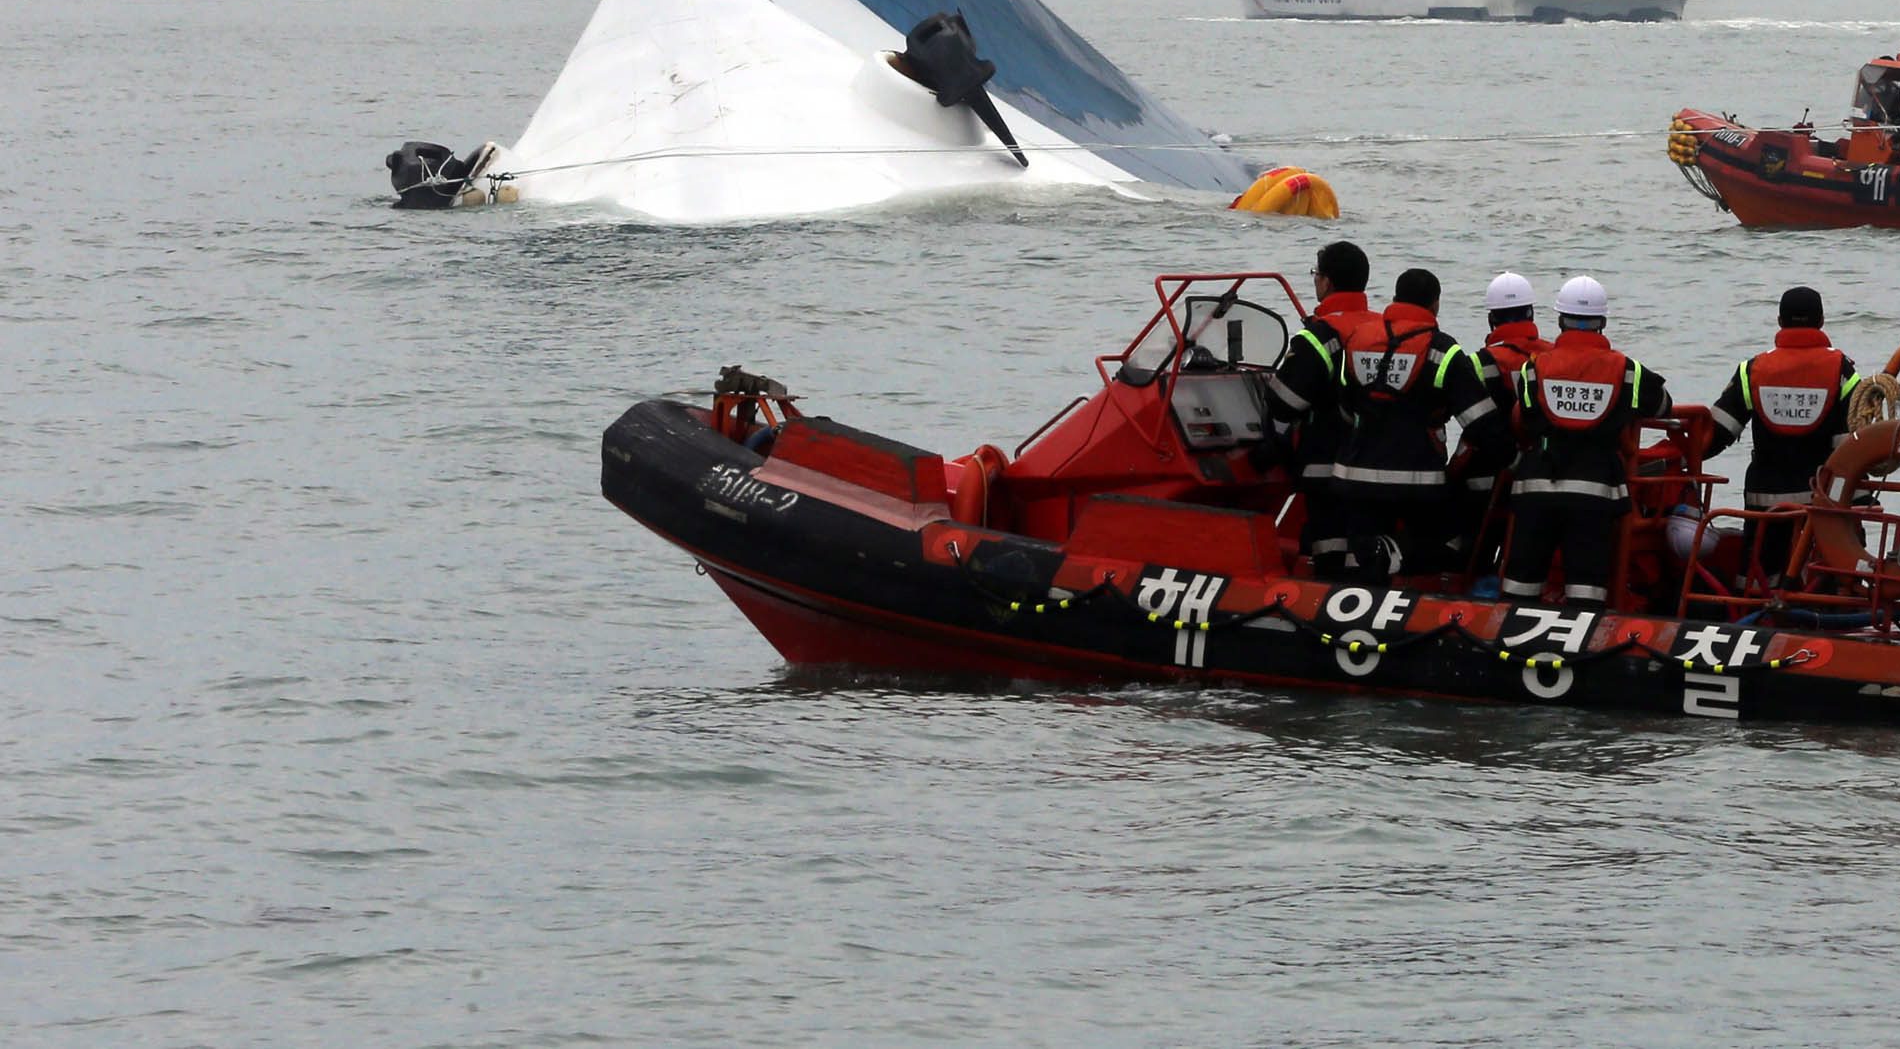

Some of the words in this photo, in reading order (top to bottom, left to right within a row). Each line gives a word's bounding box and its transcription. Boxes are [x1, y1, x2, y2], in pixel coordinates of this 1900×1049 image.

[1366, 372, 1400, 384] POCE
[1551, 385, 1604, 401] 해양경찰
[1556, 400, 1597, 413] POLICE
[1138, 568, 1761, 719] 해양경찰
